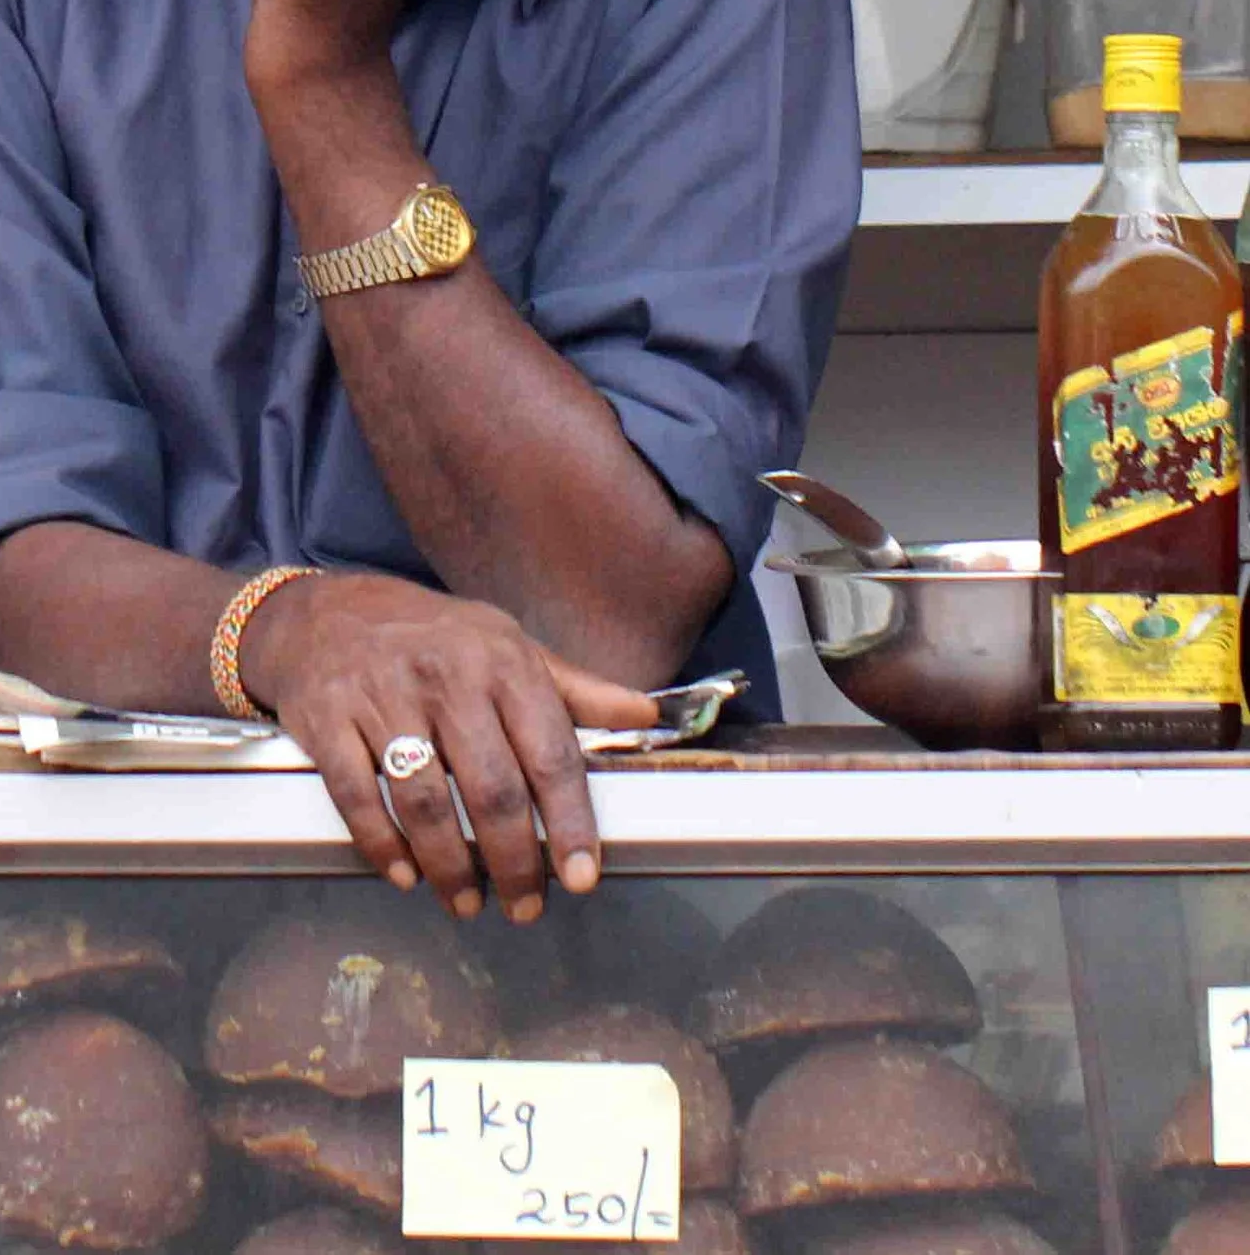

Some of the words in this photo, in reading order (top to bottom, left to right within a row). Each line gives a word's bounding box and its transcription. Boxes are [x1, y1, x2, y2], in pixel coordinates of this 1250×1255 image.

[414, 1076, 449, 1136] 1
[478, 1082, 537, 1175] kg
[515, 1147, 674, 1243] 250/=
